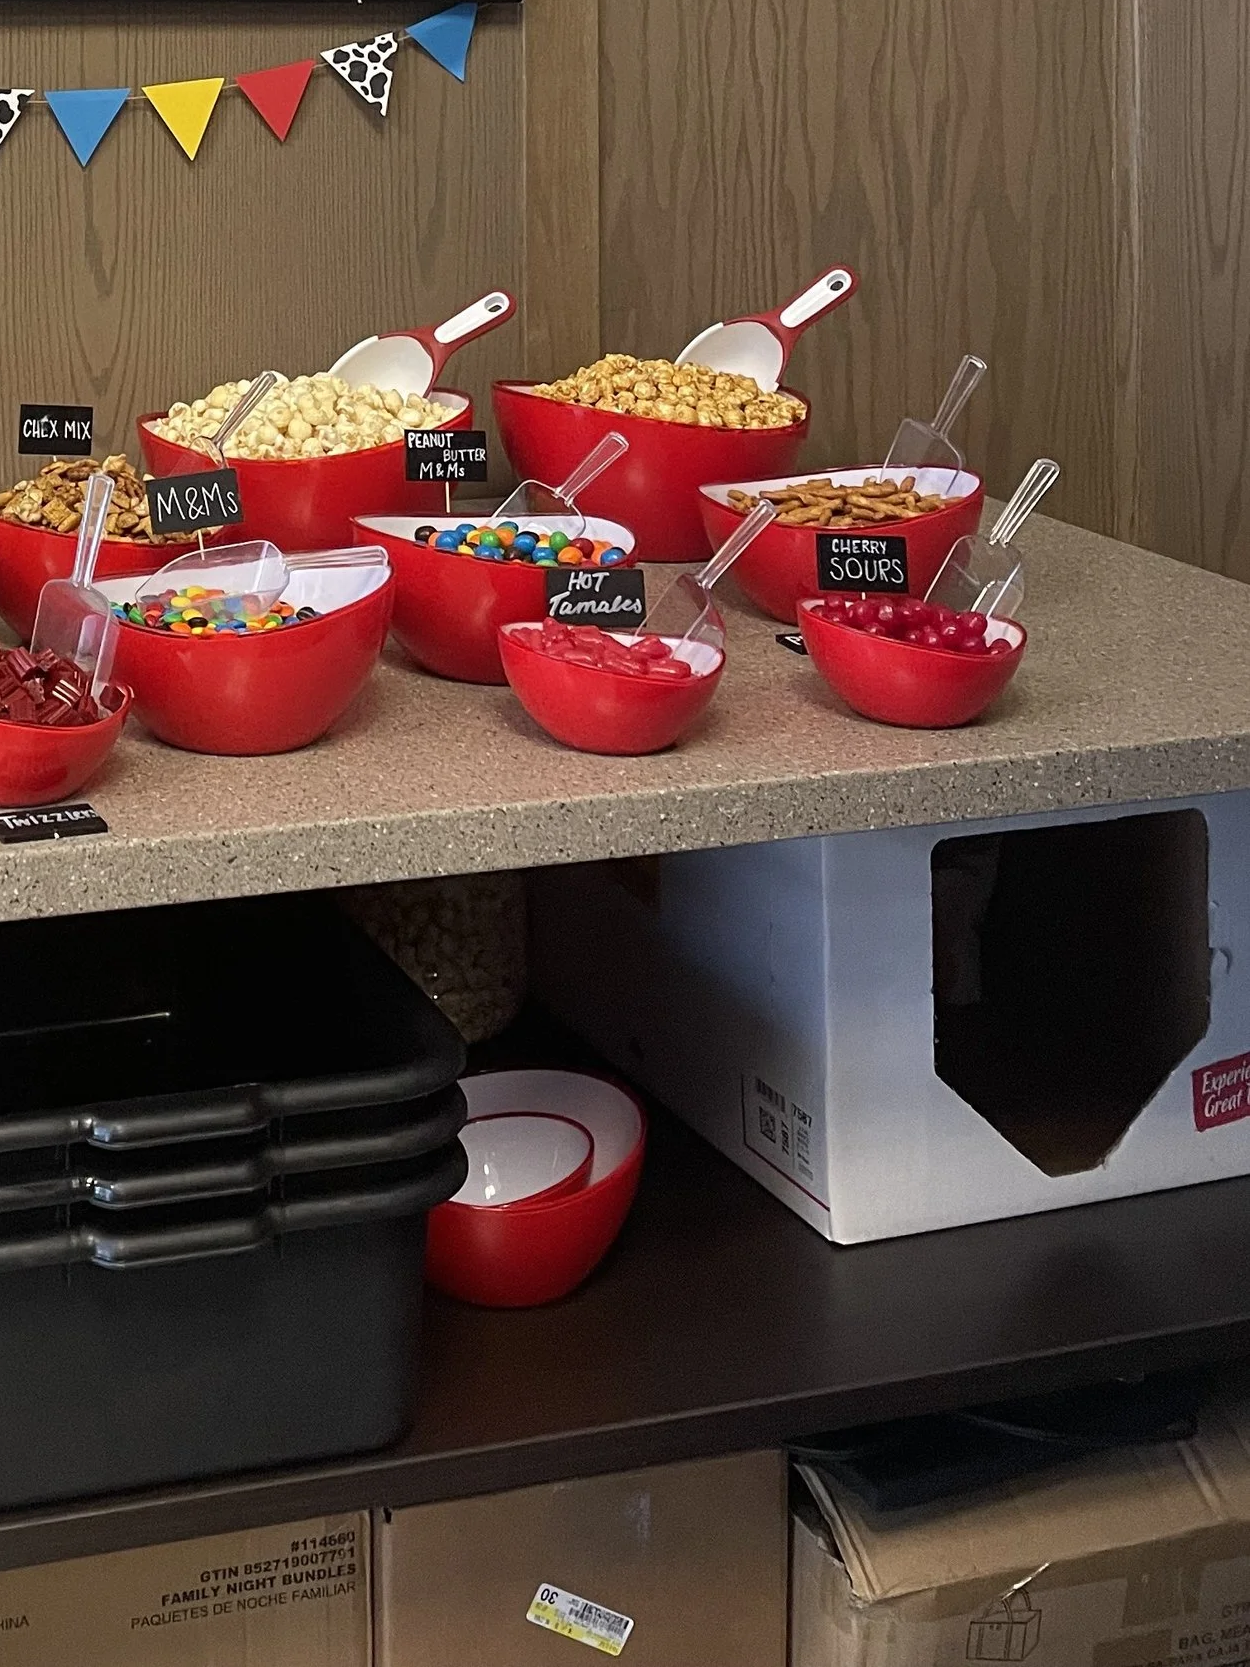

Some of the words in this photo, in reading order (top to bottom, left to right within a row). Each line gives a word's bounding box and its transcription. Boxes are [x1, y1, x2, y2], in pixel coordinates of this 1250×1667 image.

[23, 418, 59, 439] CHEX
[64, 420, 92, 440] MIX
[408, 432, 454, 449] PEANUT
[443, 448, 486, 462] BUTTER
[156, 482, 239, 523] M&Ms
[831, 538, 887, 555] CHERRY
[568, 571, 609, 592] HOT
[829, 557, 904, 584] SOURS
[549, 591, 642, 617] Tamales
[1204, 1089, 1243, 1118] Great
[161, 1585, 220, 1607] FAMILY
[226, 1576, 277, 1594] NIGHT
[282, 1563, 356, 1586] BUNDLES
[200, 1565, 239, 1583] GTIN
[131, 1605, 208, 1630] PAQUETES
[213, 1601, 233, 1615] DE
[237, 1592, 287, 1612] NOCHE
[292, 1581, 356, 1603] FAMILIAR
[540, 1588, 559, 1605] 30
